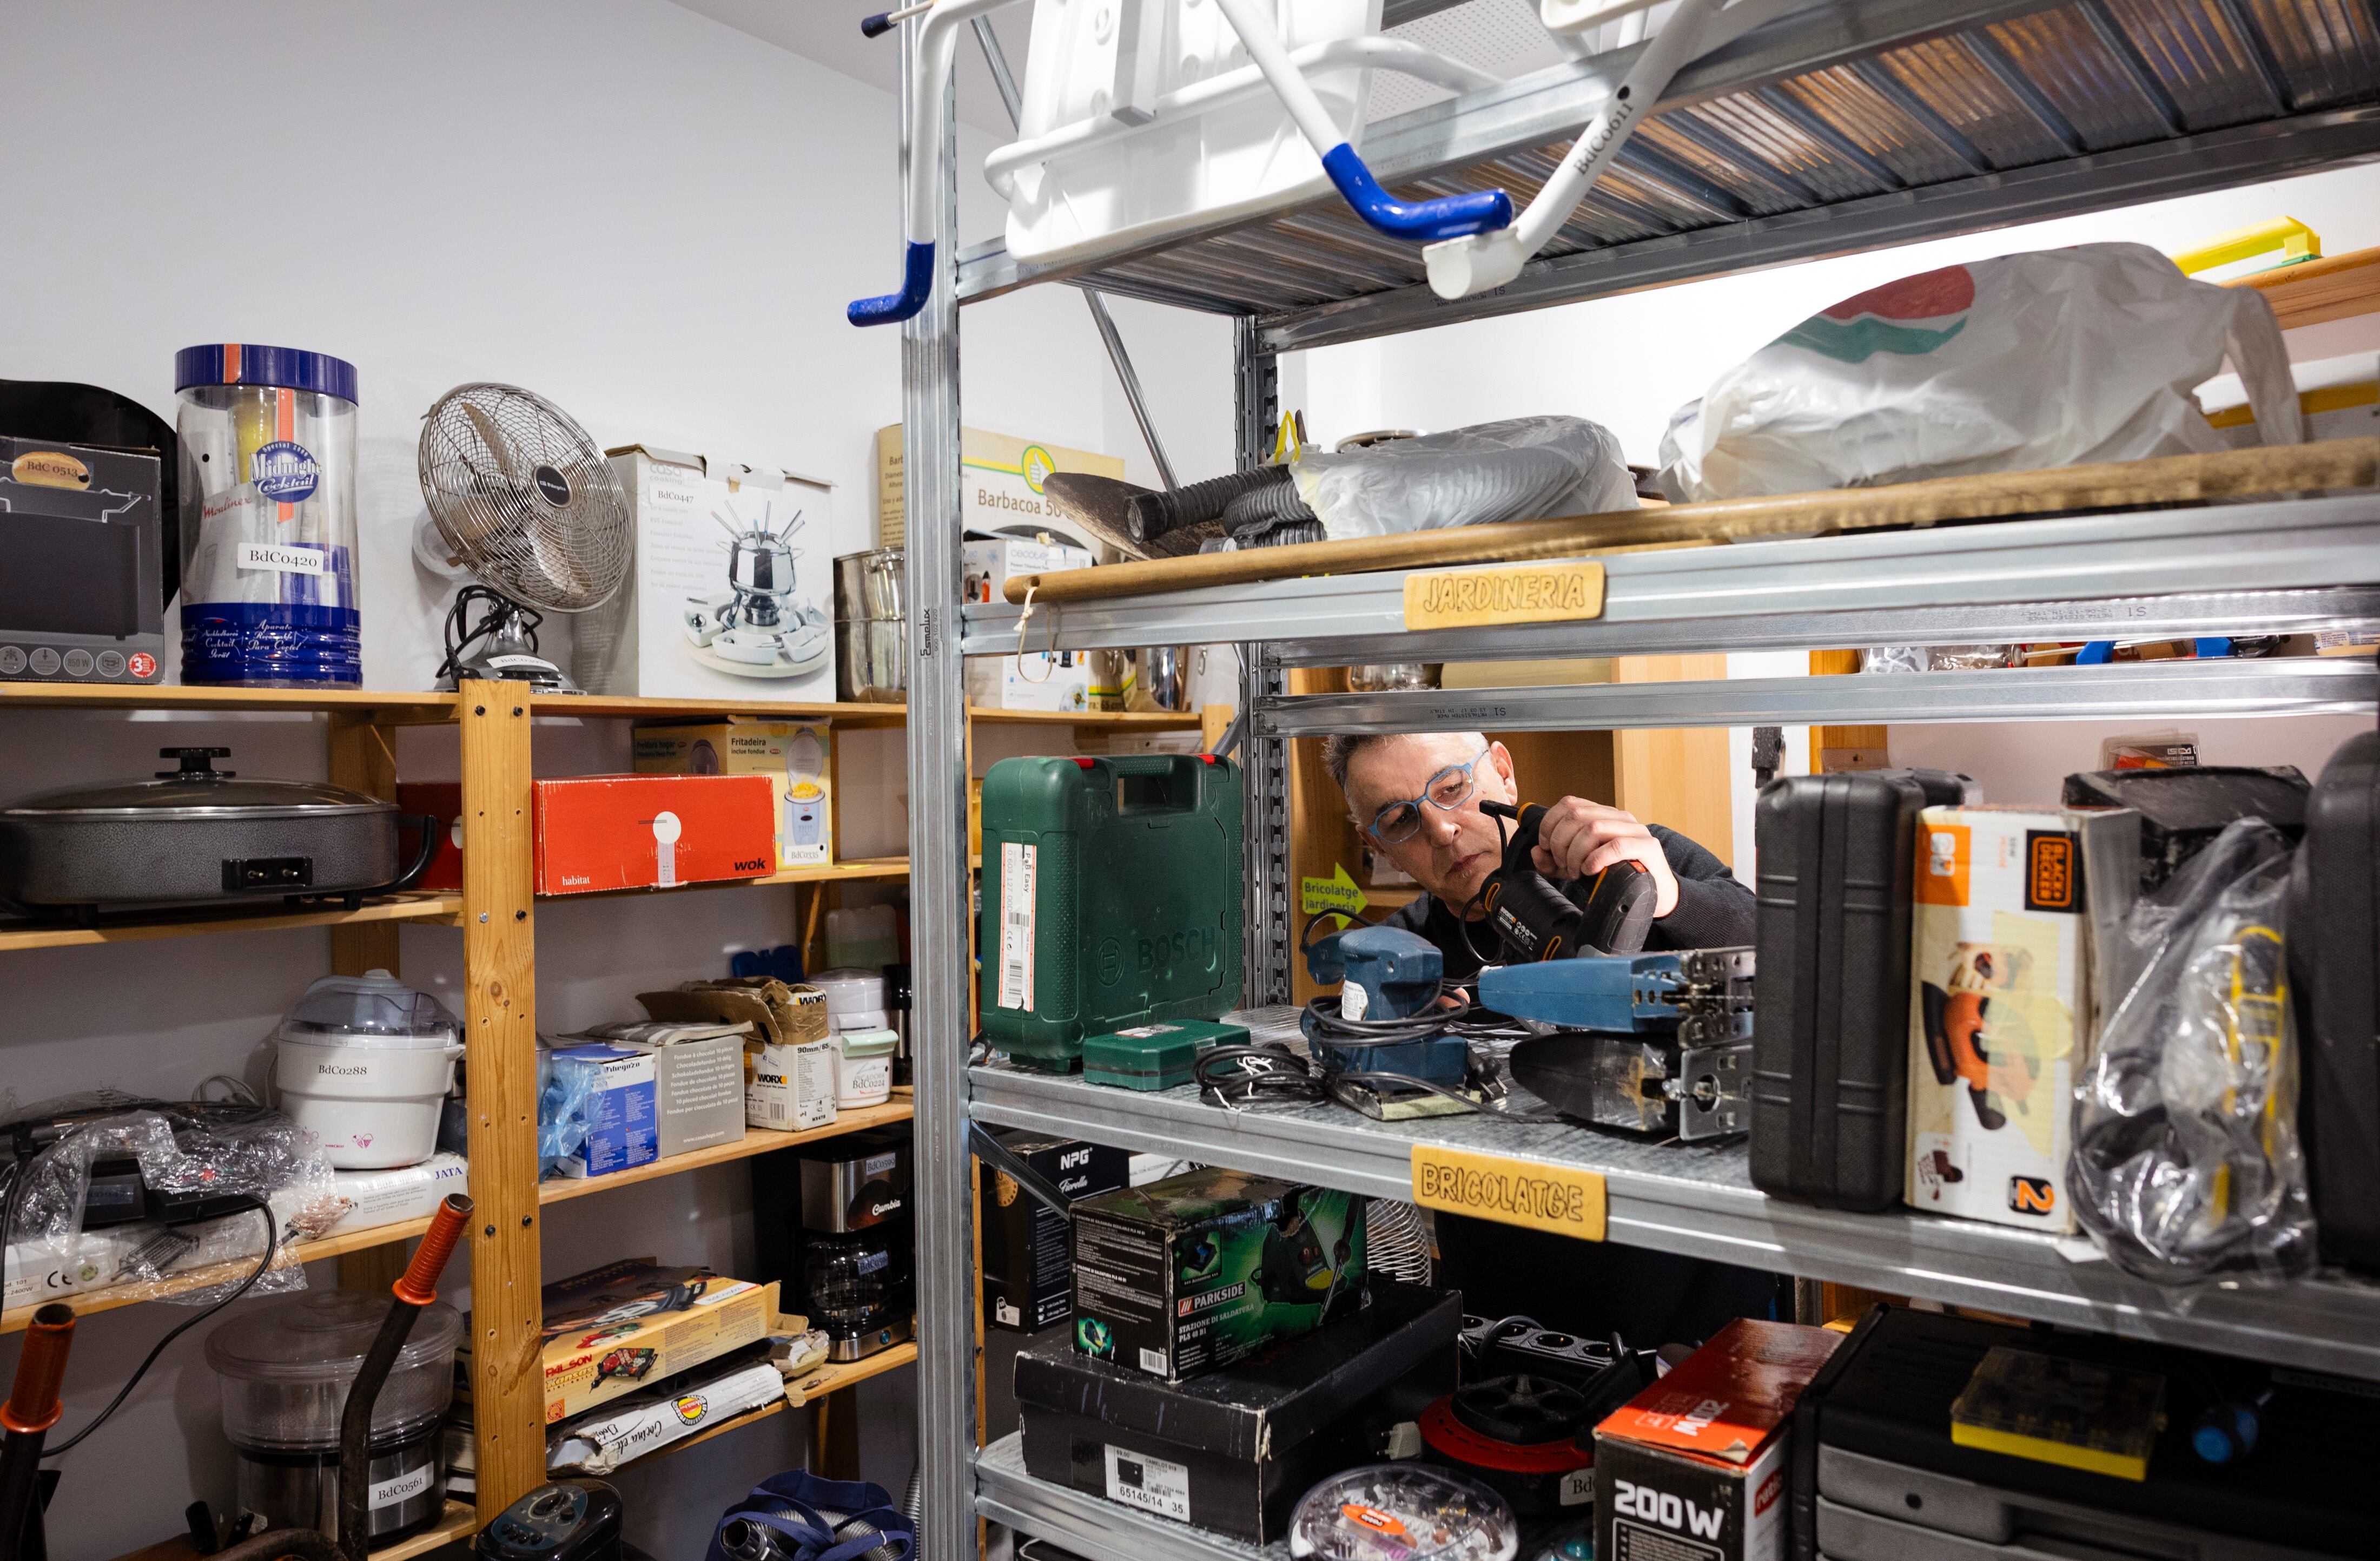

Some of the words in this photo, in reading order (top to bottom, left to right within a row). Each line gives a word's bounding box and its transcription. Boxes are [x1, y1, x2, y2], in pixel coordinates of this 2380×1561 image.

[1574, 103, 1634, 175] BdC0611
[27, 460, 50, 472] BdC
[52, 465, 78, 477] 0513
[249, 453, 322, 482] Midnight
[257, 475, 315, 495] Cocktail
[650, 476, 683, 485] cooking
[658, 490, 694, 503] BdC0447
[978, 489, 1041, 515] Barbacoa
[203, 496, 252, 518] Moulinex
[250, 550, 317, 567] BdC0420
[1424, 574, 1585, 612] JARDINERIA
[2128, 606, 2147, 617] S1
[254, 619, 293, 633] Aparato
[920, 608, 931, 656] Esmelux
[206, 638, 235, 648] Cocktail
[247, 640, 269, 650] Para
[82, 658, 90, 667] W
[1494, 707, 1506, 716] S1
[731, 737, 766, 746] Fritadeira
[734, 858, 766, 871] wok
[791, 852, 819, 860] BdC0335
[562, 875, 590, 886] habitat
[1305, 882, 1358, 899] Bricolatge
[1138, 926, 1215, 973] BOSCH
[319, 1065, 367, 1075] BdC0288
[696, 1076, 717, 1084] chocolate
[757, 1073, 783, 1085] WORX
[853, 1080, 885, 1089] BdC0224
[690, 1085, 712, 1094] chocolate
[1060, 1149, 1089, 1170] NPG
[435, 1167, 463, 1180] JATA
[1059, 1175, 1088, 1194] Fiorella
[1422, 1163, 1583, 1223] BRICOLATGE
[2017, 1180, 2055, 1211] 2
[872, 1199, 901, 1216] Cumbia
[1194, 1283, 1244, 1309] PARKSIDE
[1179, 1318, 1211, 1334] STAZIONE
[1211, 1315, 1219, 1324] DI
[1219, 1304, 1254, 1320] SALDATURA
[1179, 1333, 1191, 1343] PLS
[545, 1354, 592, 1378] PALSON
[546, 1366, 594, 1389] Kansas
[630, 1420, 662, 1443] Cocina
[1145, 1458, 1167, 1468] CAMELOT
[379, 1477, 423, 1500] BdC0561
[1120, 1486, 1162, 1507] 65145/14
[1615, 1479, 1683, 1530] 200
[1685, 1498, 1725, 1542] W
